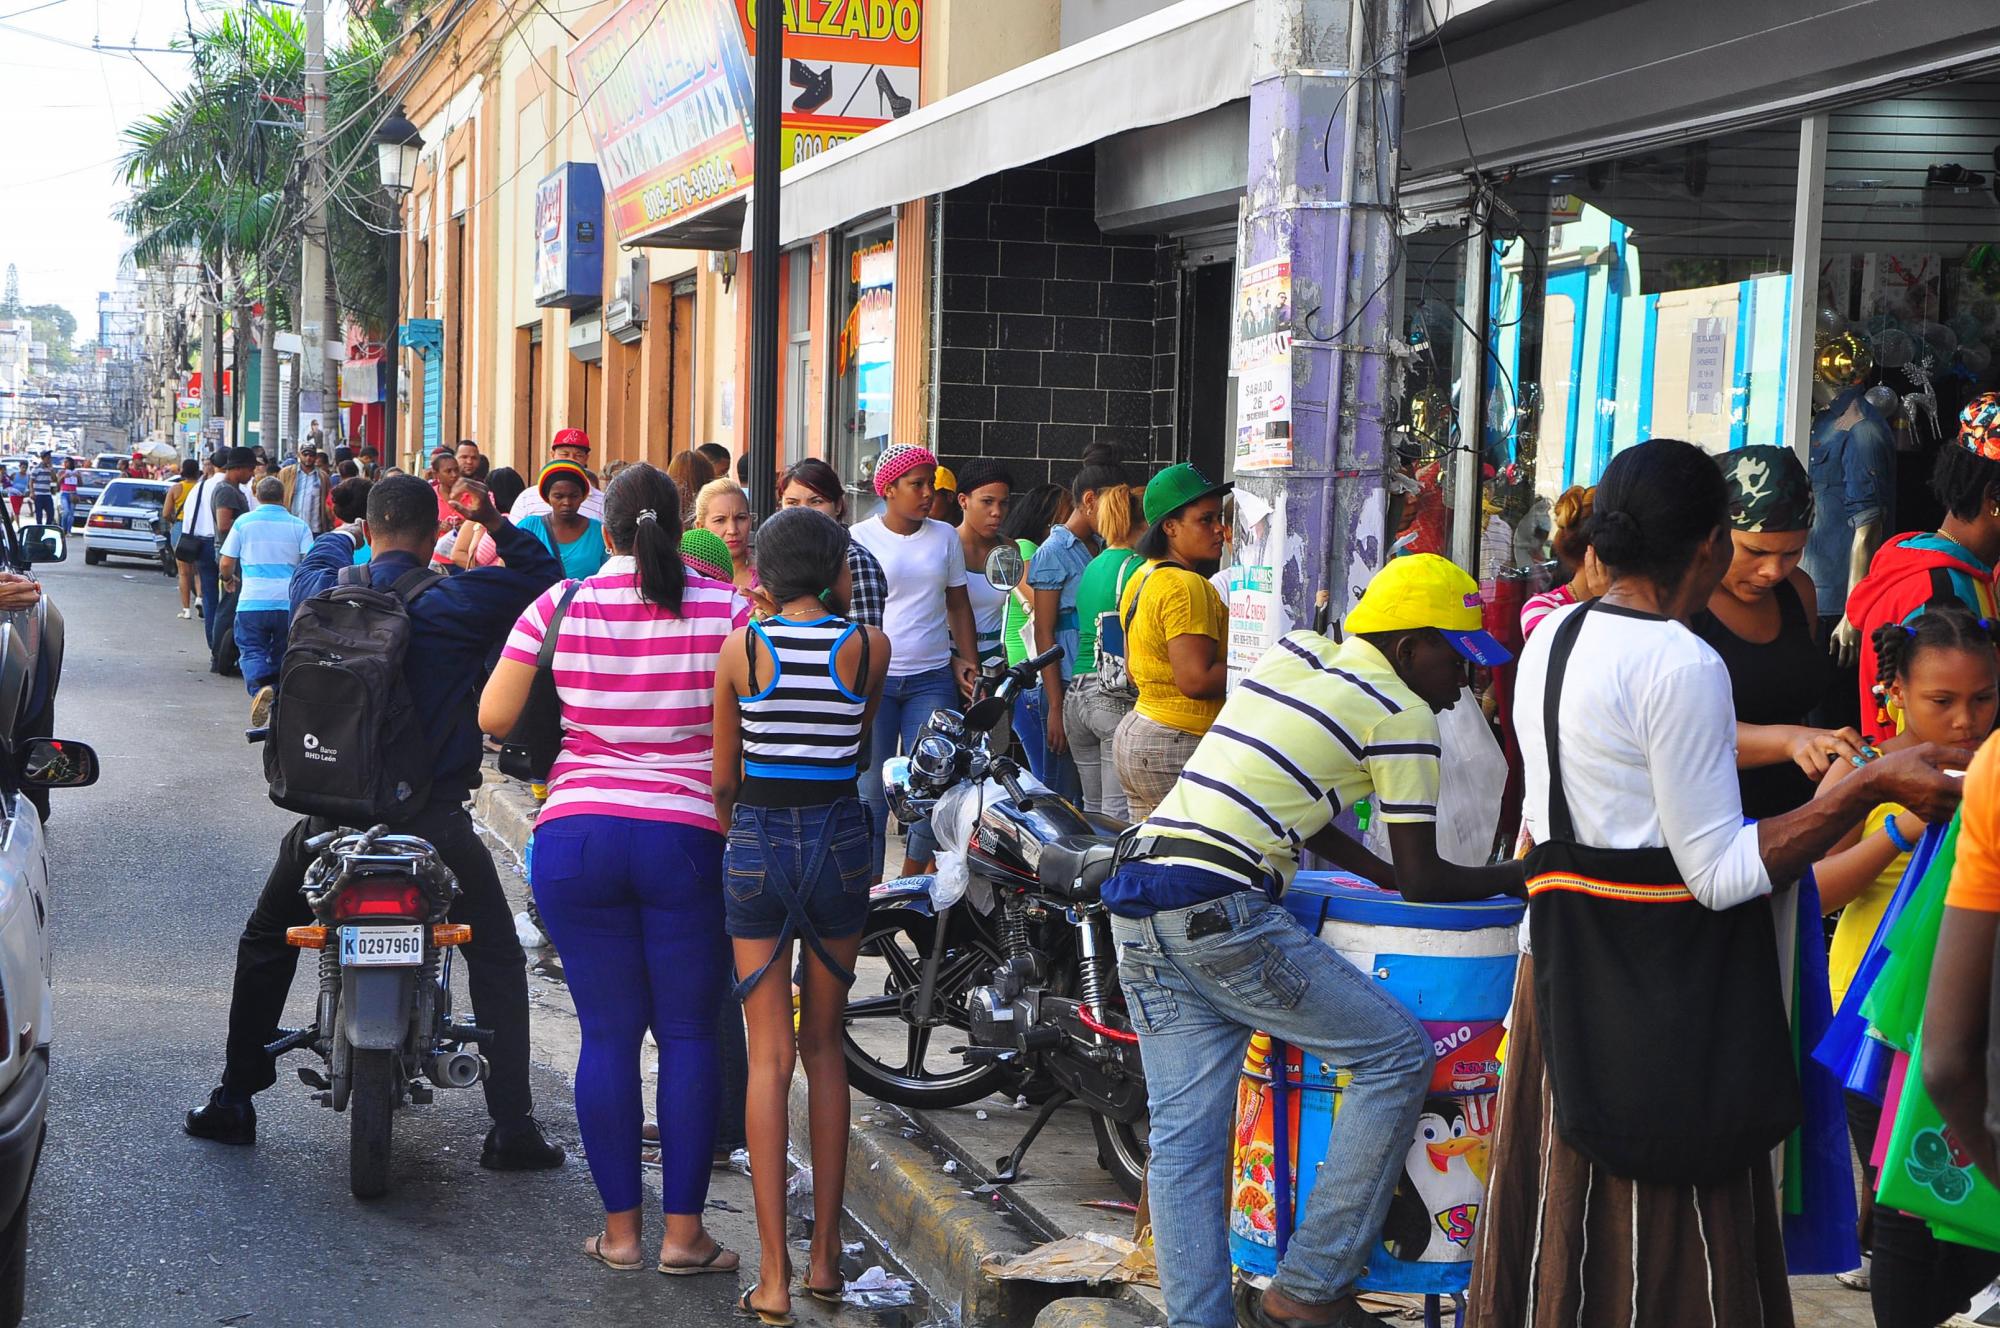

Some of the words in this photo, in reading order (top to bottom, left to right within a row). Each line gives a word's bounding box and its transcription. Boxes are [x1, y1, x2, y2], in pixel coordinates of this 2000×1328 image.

[643, 156, 725, 221] 809-276-9984
[304, 751, 320, 760] BHD
[320, 753, 337, 763] León
[320, 745, 338, 755] Banco
[1434, 1025, 1471, 1057] evo
